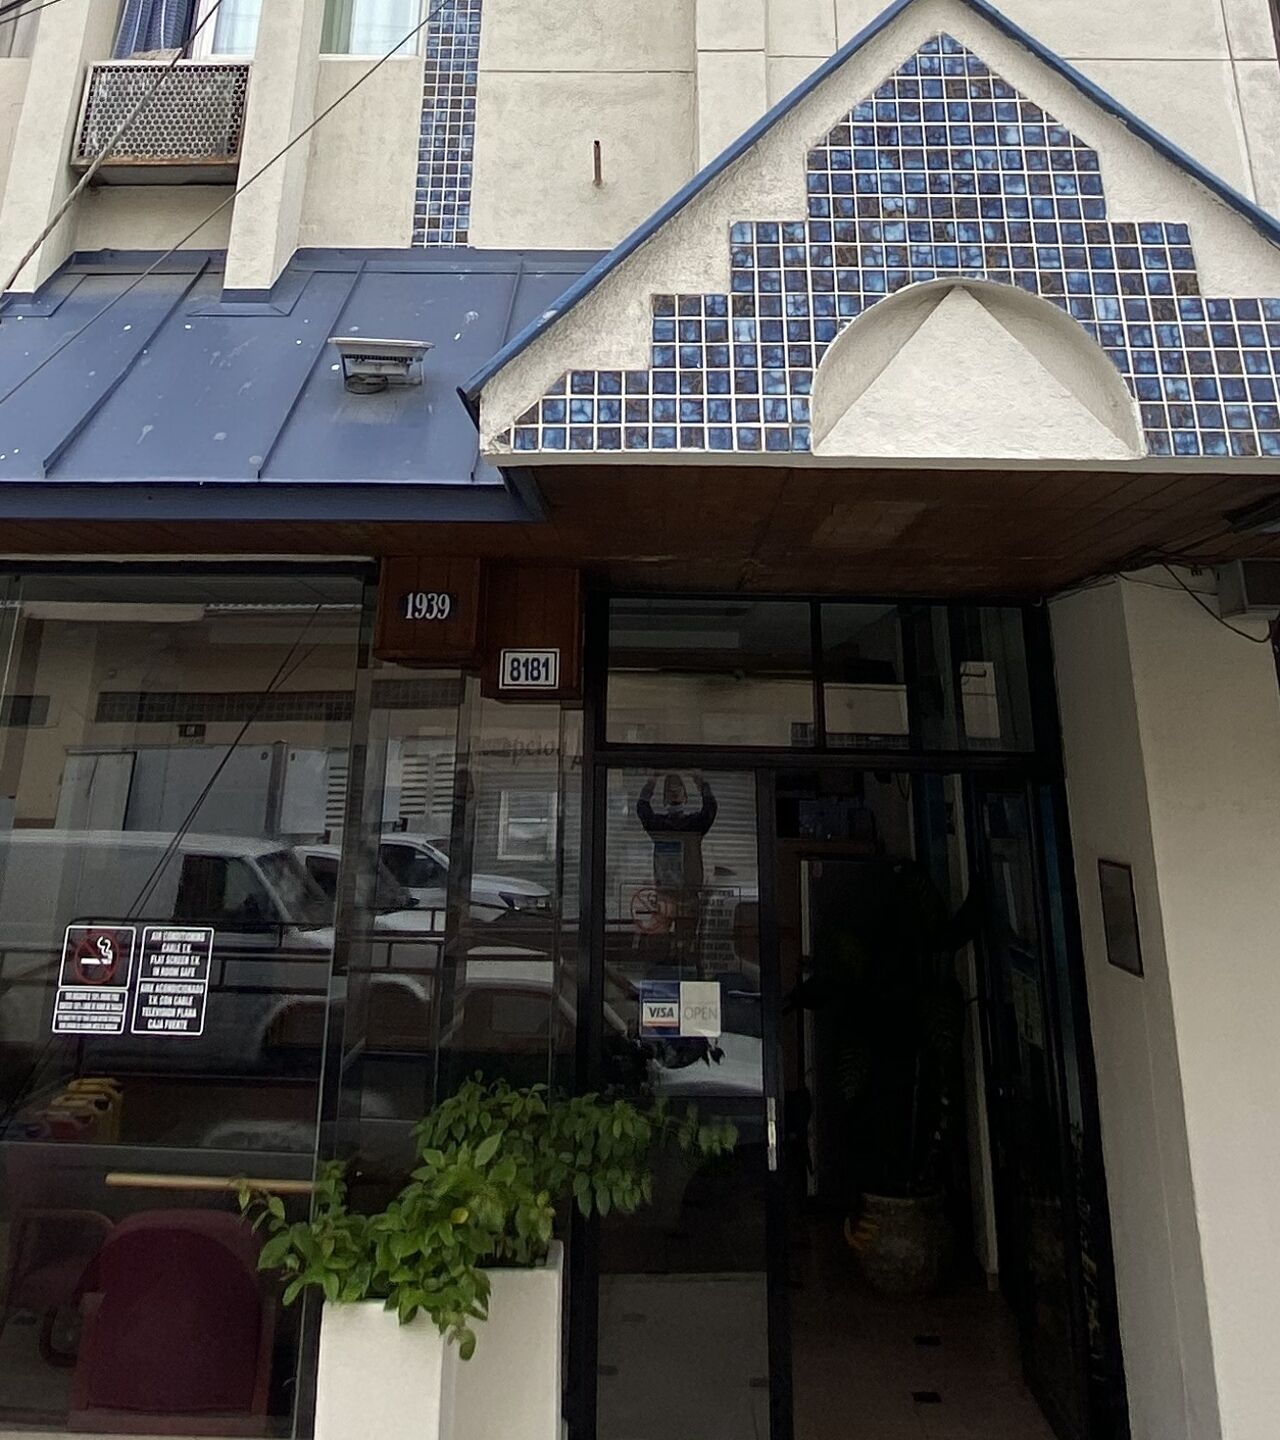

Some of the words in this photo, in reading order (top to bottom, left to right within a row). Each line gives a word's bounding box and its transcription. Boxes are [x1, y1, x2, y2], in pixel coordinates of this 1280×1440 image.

[405, 592, 450, 620] 1939
[509, 657, 550, 682] 8181
[648, 1006, 674, 1018] VISA
[683, 1007, 717, 1021] OPEN
